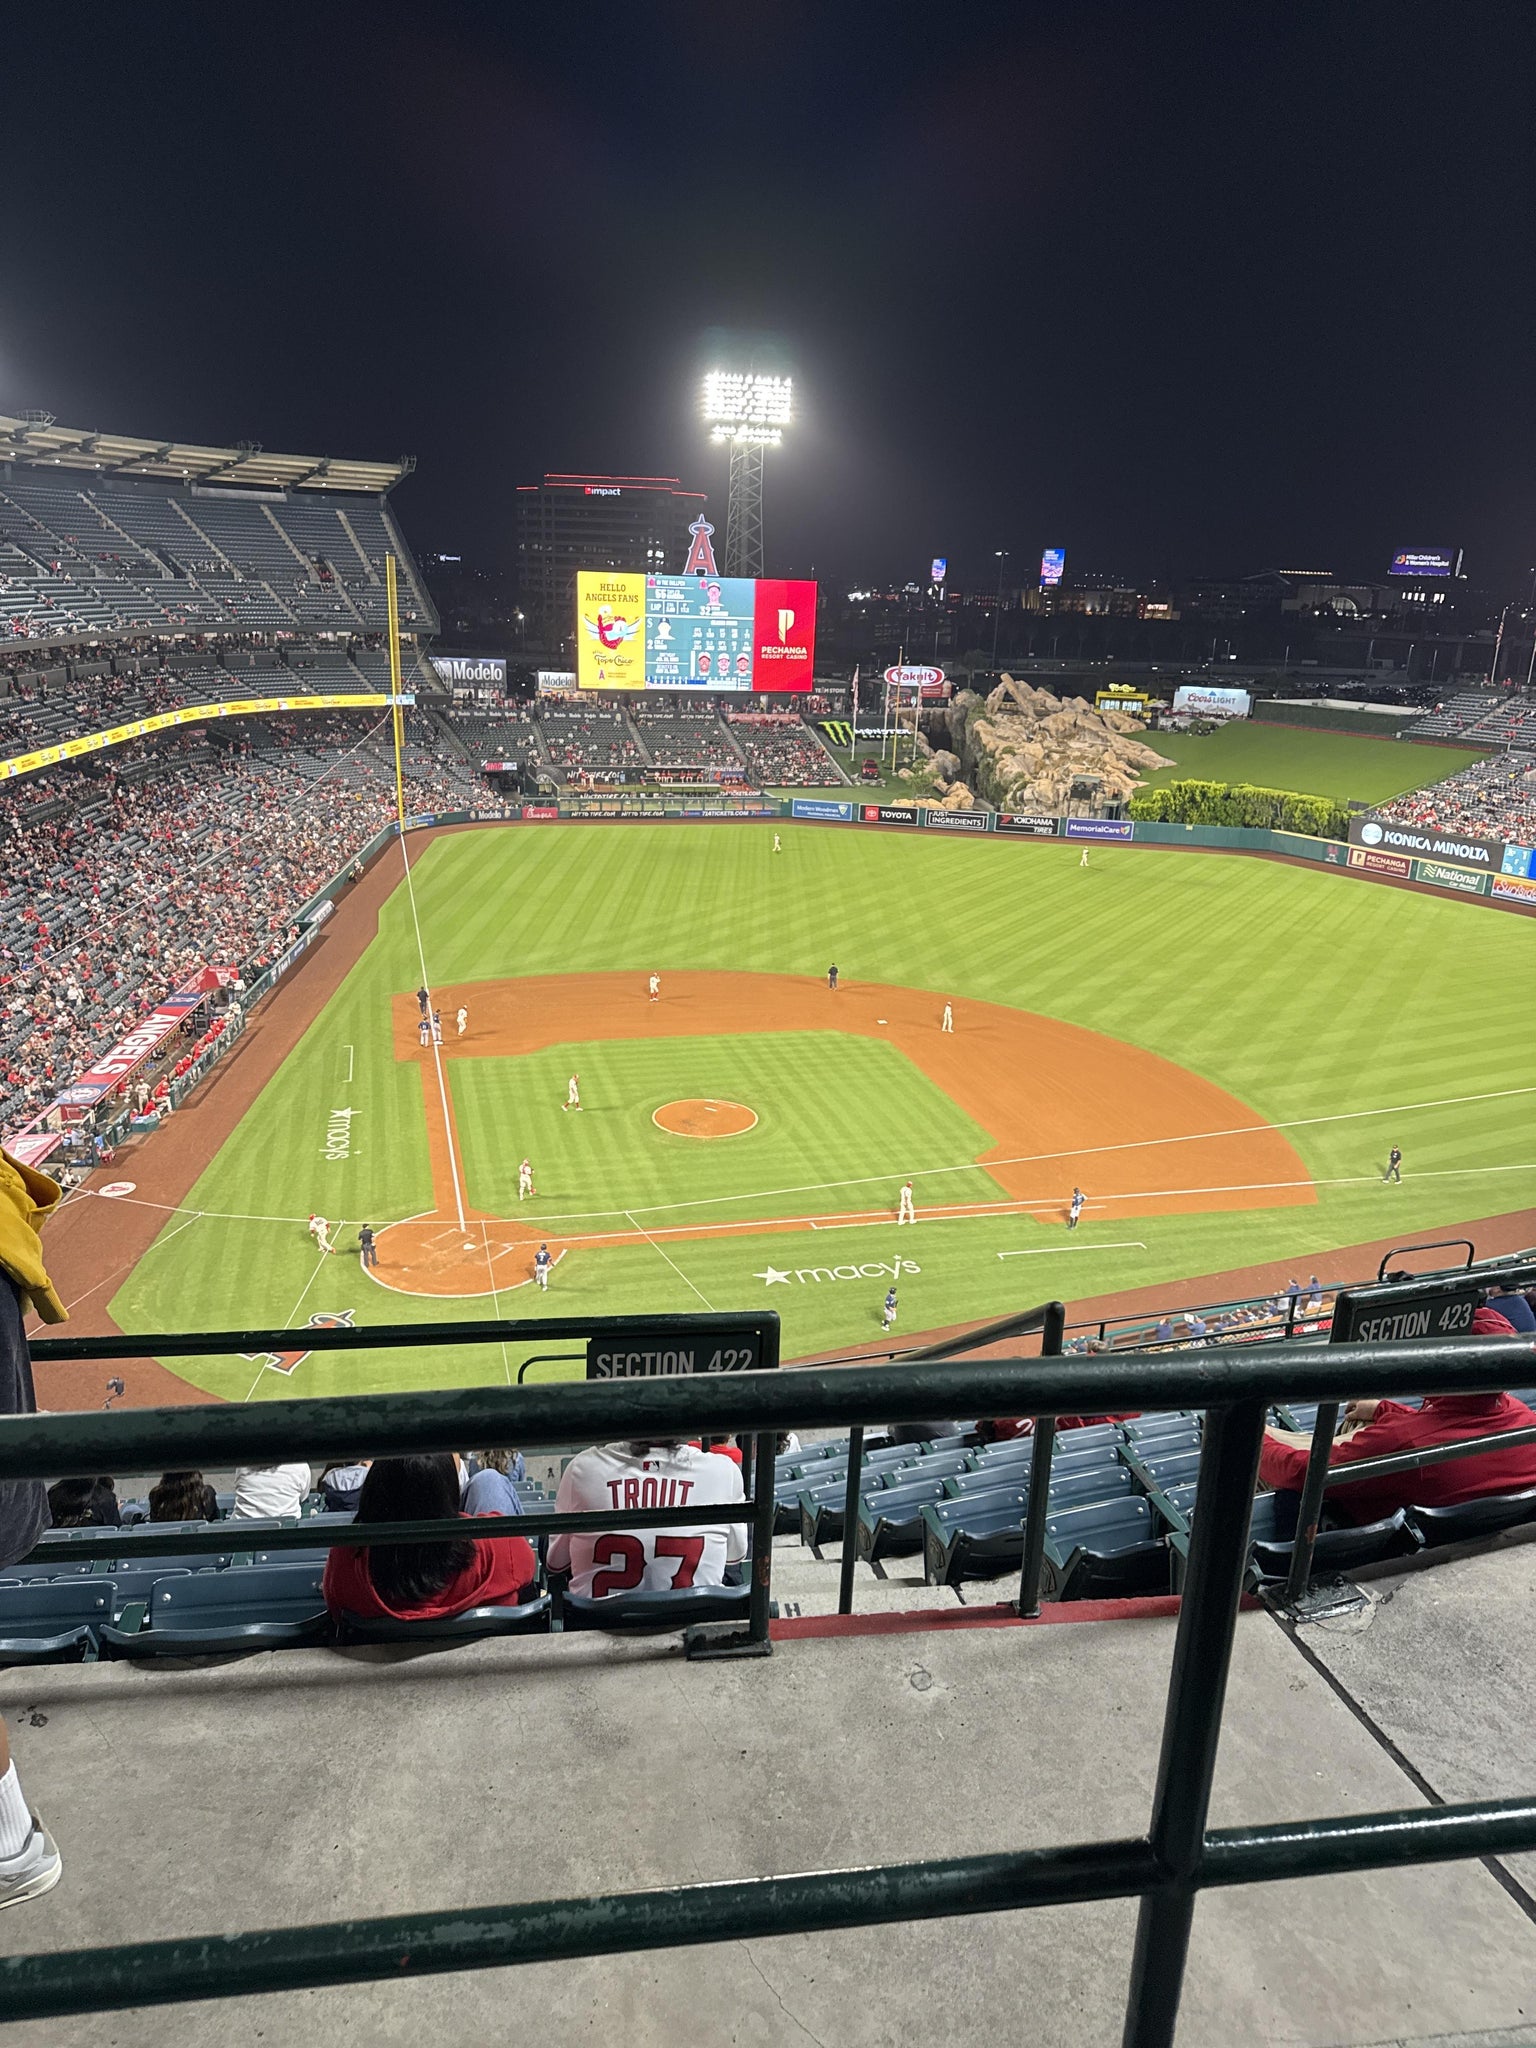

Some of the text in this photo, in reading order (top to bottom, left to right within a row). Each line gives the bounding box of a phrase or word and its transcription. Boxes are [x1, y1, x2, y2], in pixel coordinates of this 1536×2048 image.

[591, 488, 621, 496] impact
[600, 583, 626, 592] HELLO
[585, 593, 639, 603] ANGELS FANS
[761, 646, 807, 654] PECHANGA
[453, 661, 502, 681] Modelo
[543, 674, 572, 687] Modelo
[1187, 693, 1236, 705] Coors LIGHT
[478, 810, 501, 820] Modelo
[881, 811, 912, 820] TOYOTA
[932, 816, 981, 827] INGREDIENTS
[1033, 826, 1053, 834] TIRES
[1070, 823, 1120, 834] MemorialCare
[1384, 830, 1490, 862] KONICA MINOLTA
[1366, 855, 1406, 869] PECHANGA
[1435, 865, 1480, 886] National
[91, 1013, 179, 1075] ANGELS
[1357, 1303, 1472, 1343] SECTION 423
[596, 1350, 753, 1378] SECTION 422
[607, 1478, 695, 1509] TROUT
[592, 1533, 705, 1599] 27
